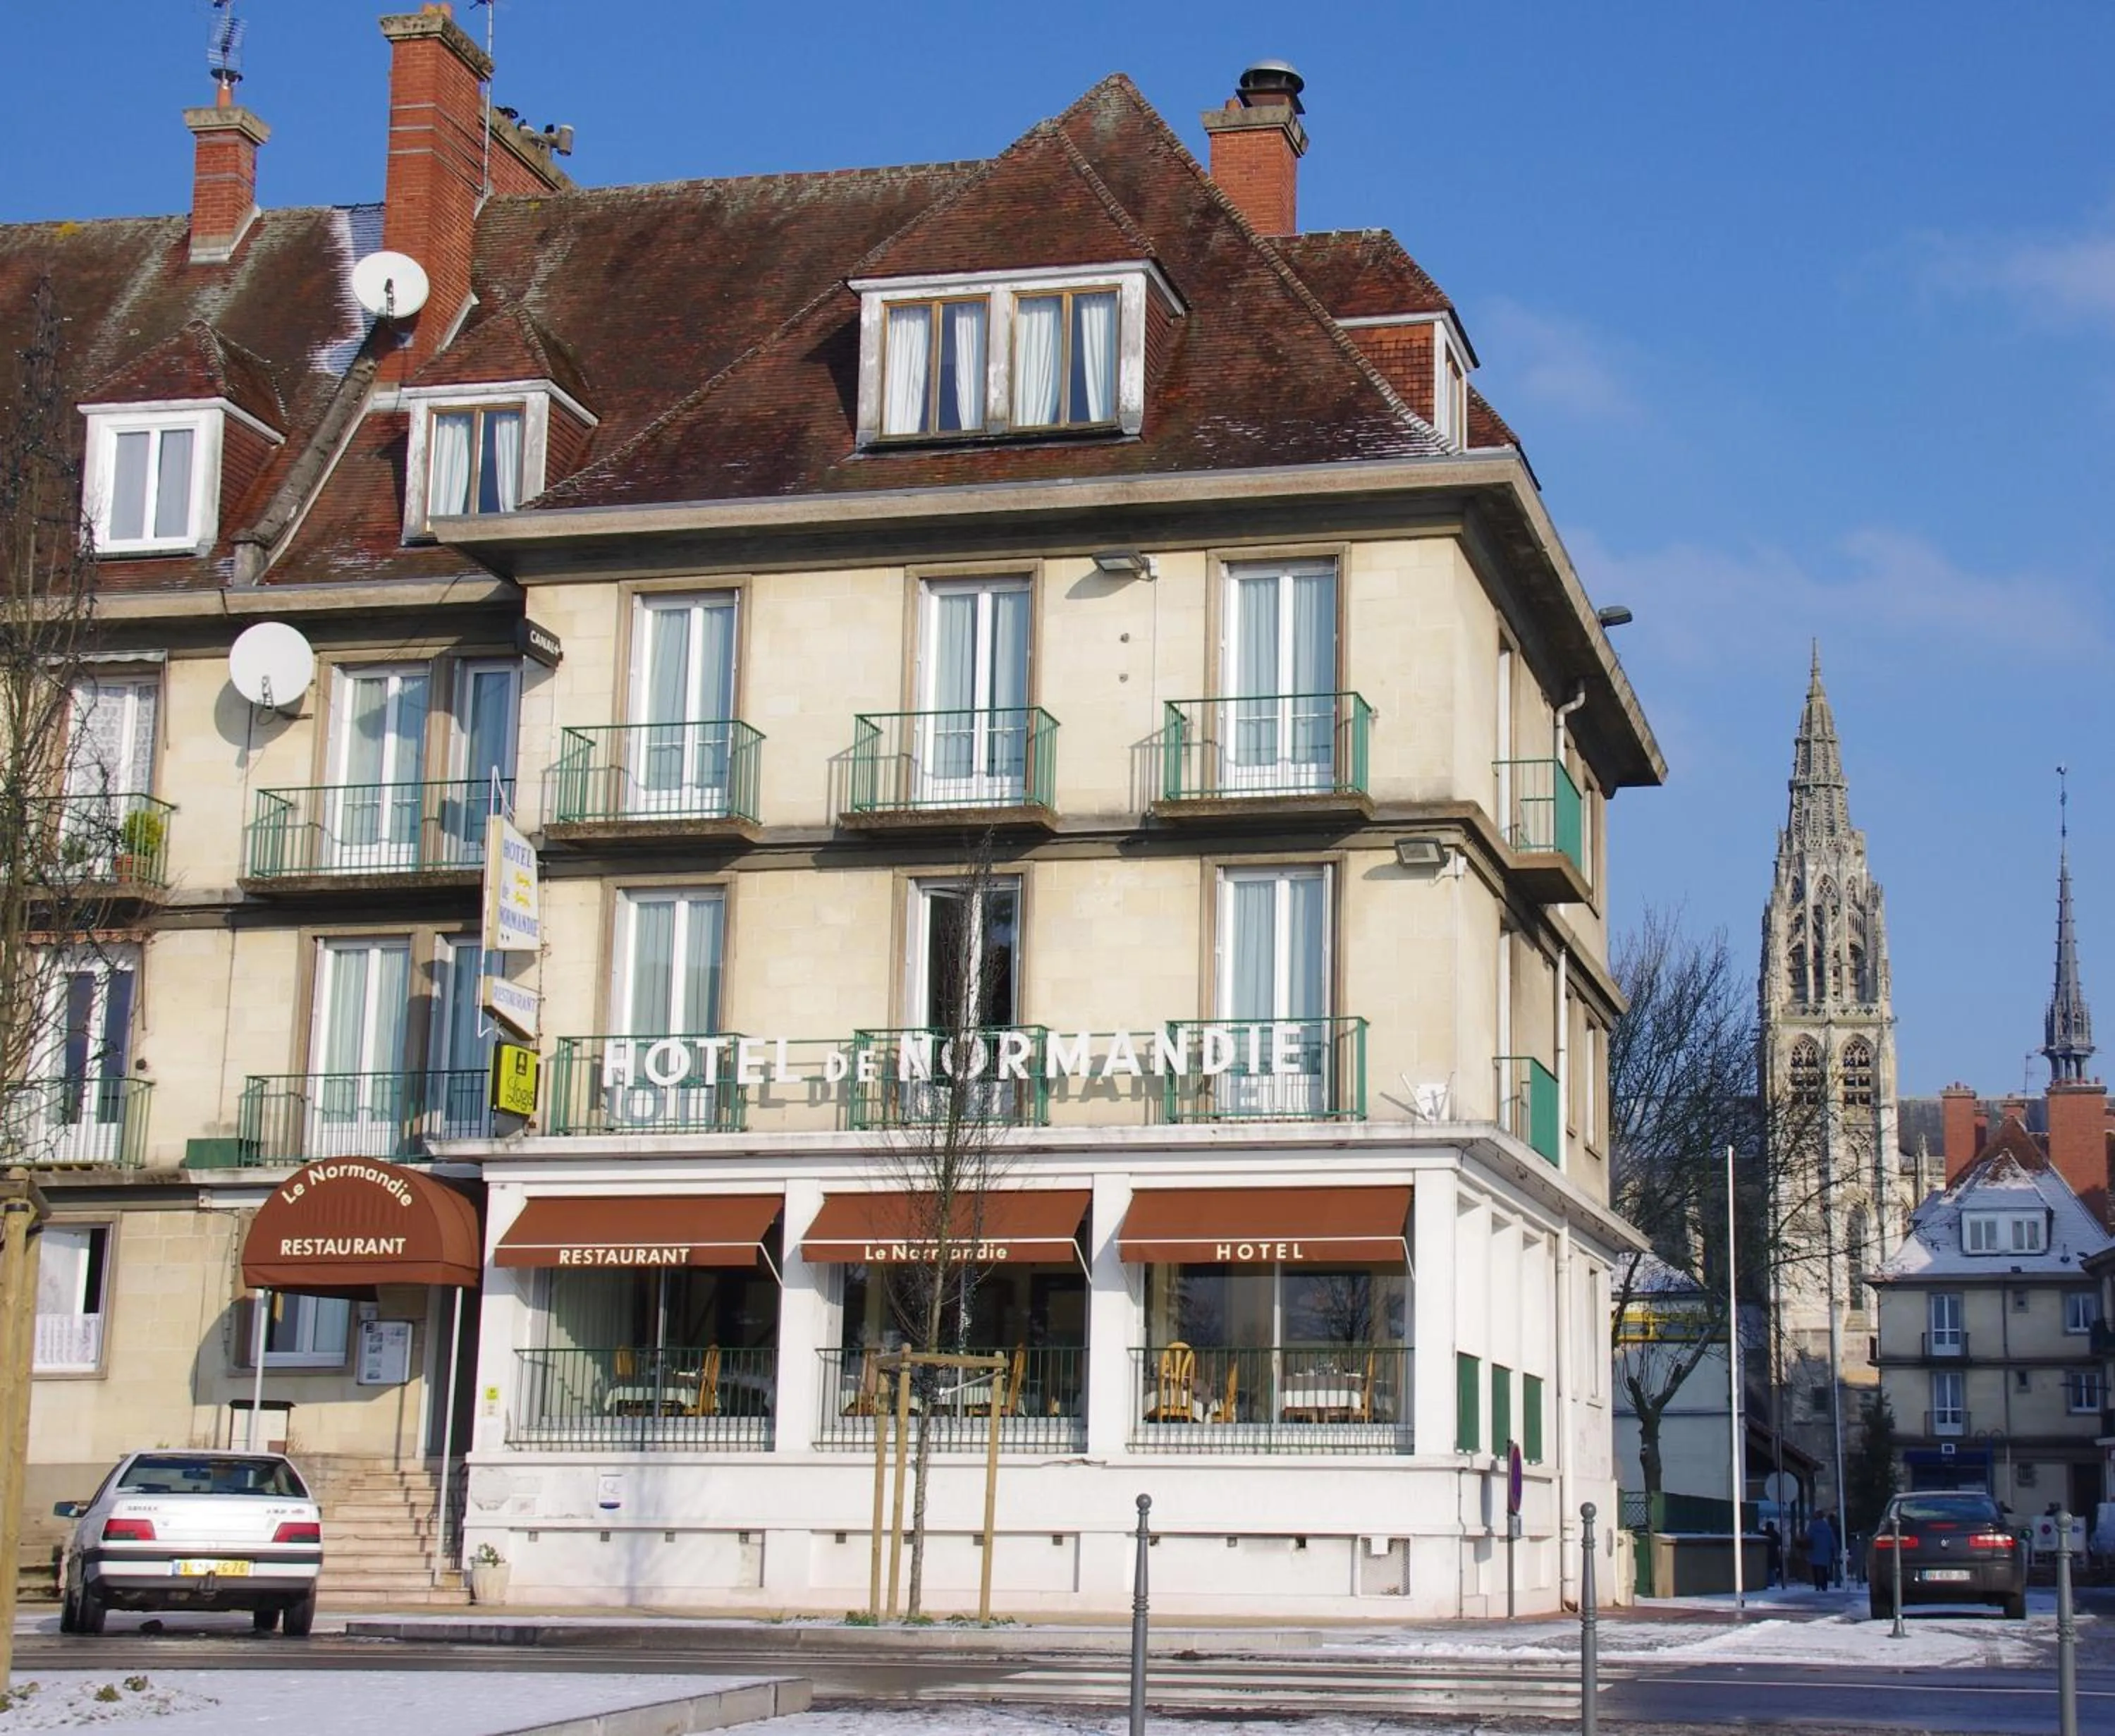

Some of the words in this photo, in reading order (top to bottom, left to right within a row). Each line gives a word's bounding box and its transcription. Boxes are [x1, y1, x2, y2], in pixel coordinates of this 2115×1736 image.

[503, 838, 532, 868] HOTEL
[499, 905, 538, 937] NORMANDIE
[494, 984, 535, 1013] RESTAURANT
[603, 1036, 800, 1087] HOTEL
[826, 1050, 876, 1082] DE
[899, 1022, 1299, 1081] NORMANDIE
[506, 1076, 534, 1111] Logis
[282, 1182, 305, 1204] Le
[308, 1164, 412, 1206] Normandie
[281, 1237, 406, 1256] RESTAURANT
[559, 1248, 689, 1264] RESTAURANT
[865, 1245, 885, 1260] Le
[1216, 1243, 1304, 1260] HOTEL
